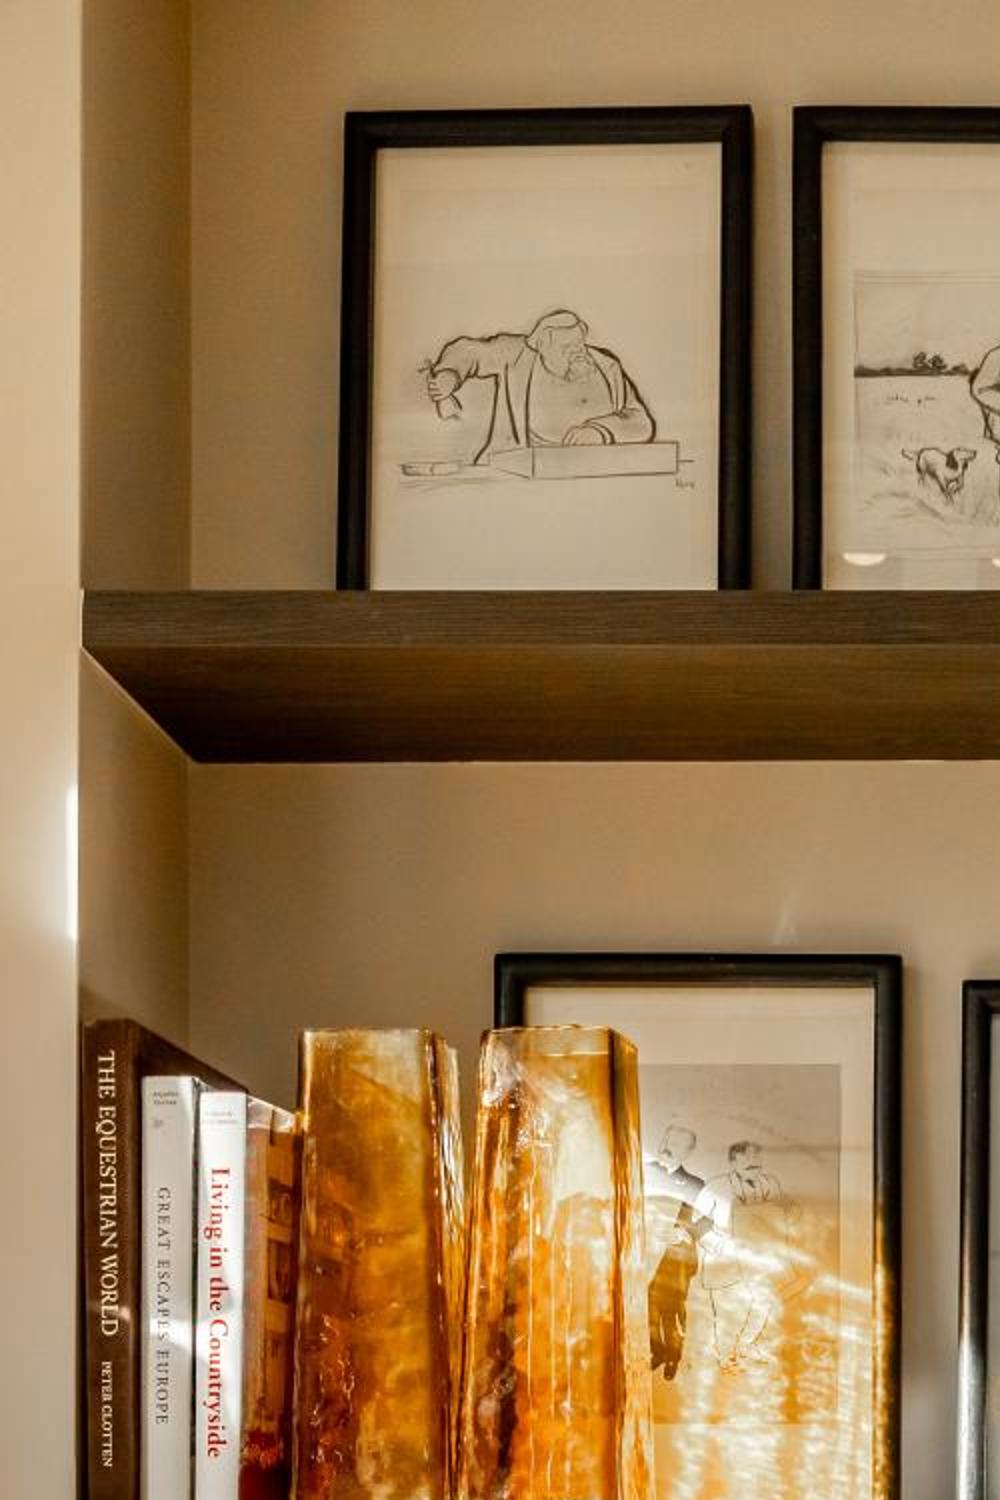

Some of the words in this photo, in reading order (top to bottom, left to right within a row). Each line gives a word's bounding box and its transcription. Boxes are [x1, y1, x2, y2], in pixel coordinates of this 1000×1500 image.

[98, 1050, 116, 1098] THE
[96, 1105, 118, 1248] EQUESTRIAN
[202, 1167, 231, 1240] Living
[155, 1187, 171, 1249] GREAT
[210, 1246, 230, 1268] in
[98, 1253, 118, 1336] WORLD
[155, 1259, 171, 1341] ESCAPES
[209, 1276, 231, 1311] the
[100, 1360, 114, 1402] PETER
[155, 1349, 171, 1425] EUROPE
[202, 1319, 231, 1458] Countryside
[100, 1405, 114, 1467] CLOTTEN
